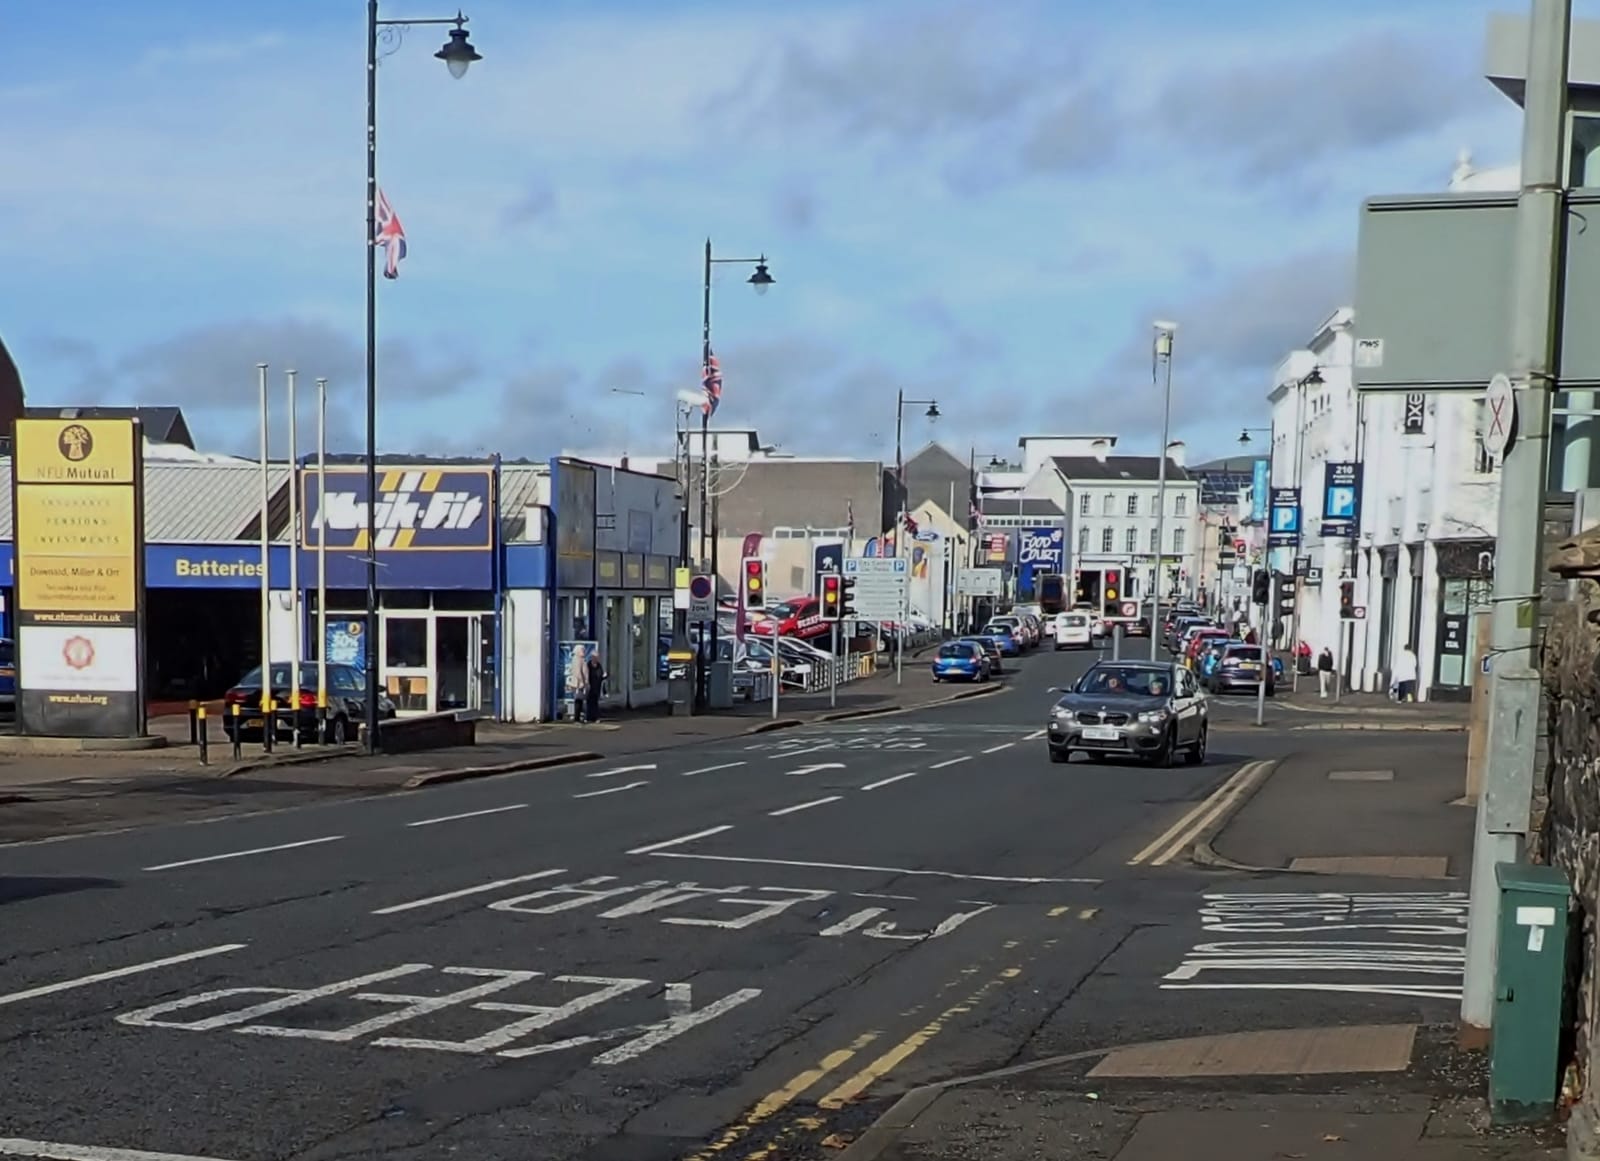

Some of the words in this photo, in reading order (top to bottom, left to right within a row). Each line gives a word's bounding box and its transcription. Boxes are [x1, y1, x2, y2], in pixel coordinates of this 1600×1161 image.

[36, 467, 64, 479] NFU
[66, 466, 115, 479] Mutual
[1335, 466, 1353, 475] 210
[311, 492, 483, 529] Kwik-Fit
[33, 536, 119, 544] INVESTMENTS
[1020, 549, 1061, 563] COURT
[97, 568, 104, 576] &
[176, 559, 265, 576] Batteries
[1158, 941, 1468, 1000] ONLY
[115, 962, 762, 1065] KEEP
